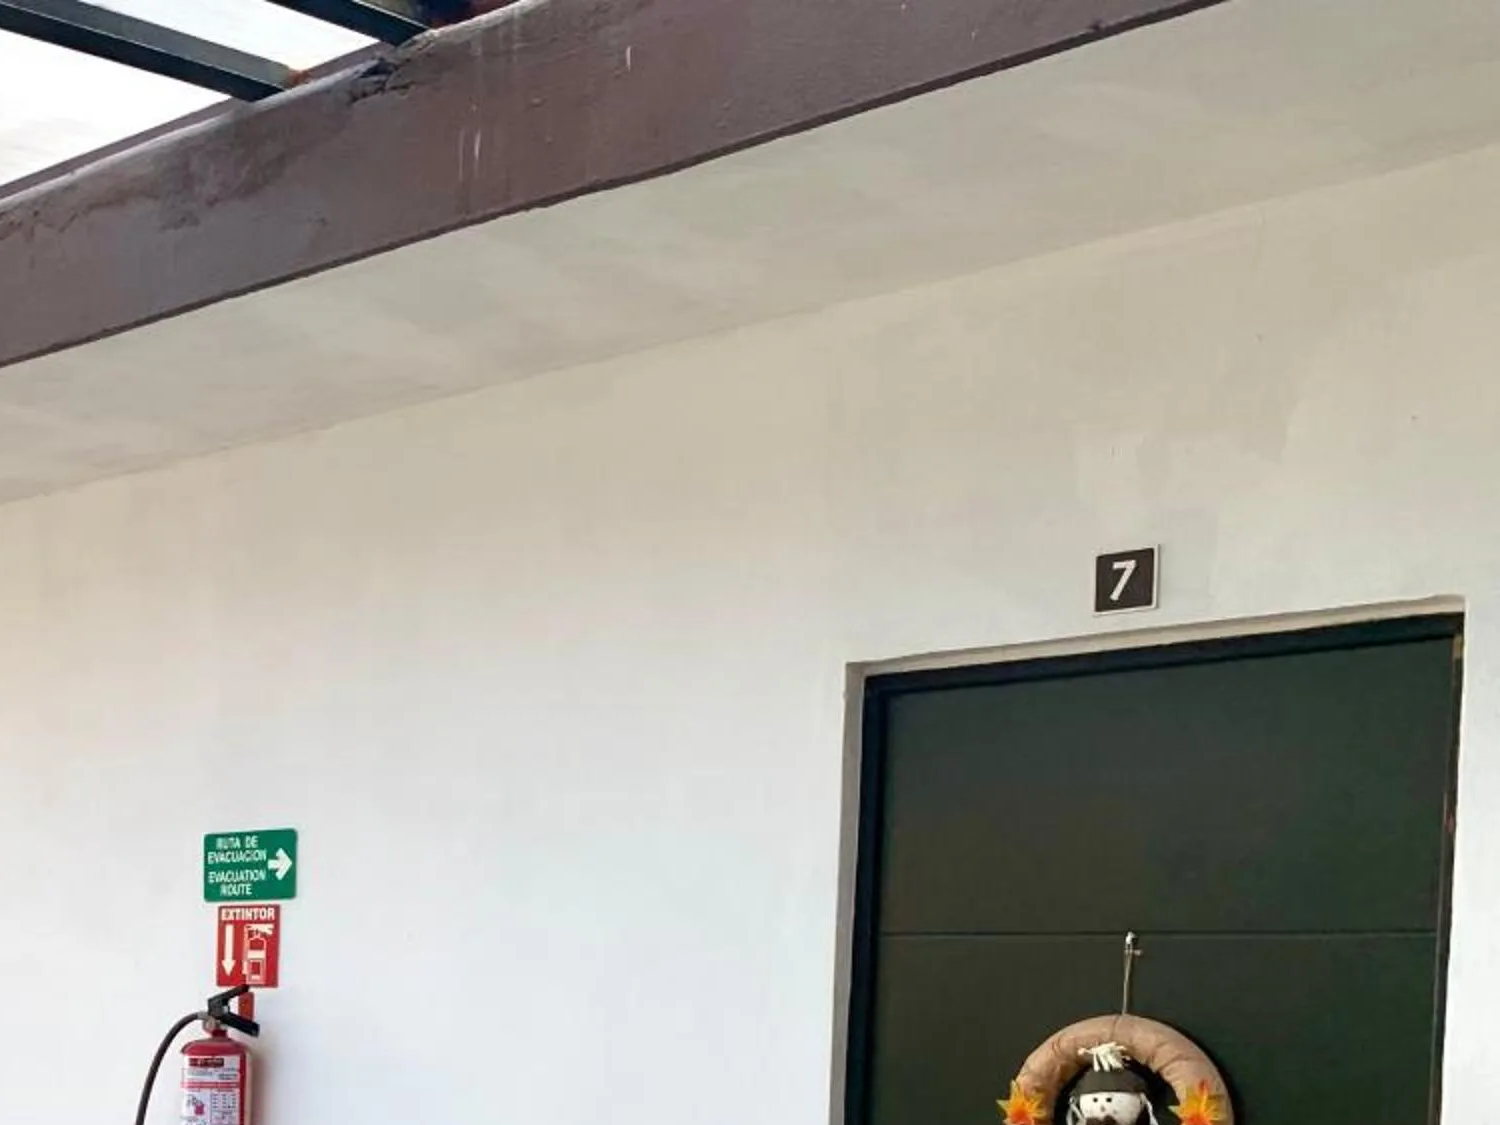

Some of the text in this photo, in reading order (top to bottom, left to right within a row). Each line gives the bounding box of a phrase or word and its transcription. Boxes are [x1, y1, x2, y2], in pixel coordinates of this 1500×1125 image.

[1110, 559, 1136, 601] 7
[216, 835, 259, 850] RUTA DE
[208, 869, 267, 884] EVACUATION
[220, 883, 253, 897] ROUTE
[221, 908, 275, 921] EXTINTOR
